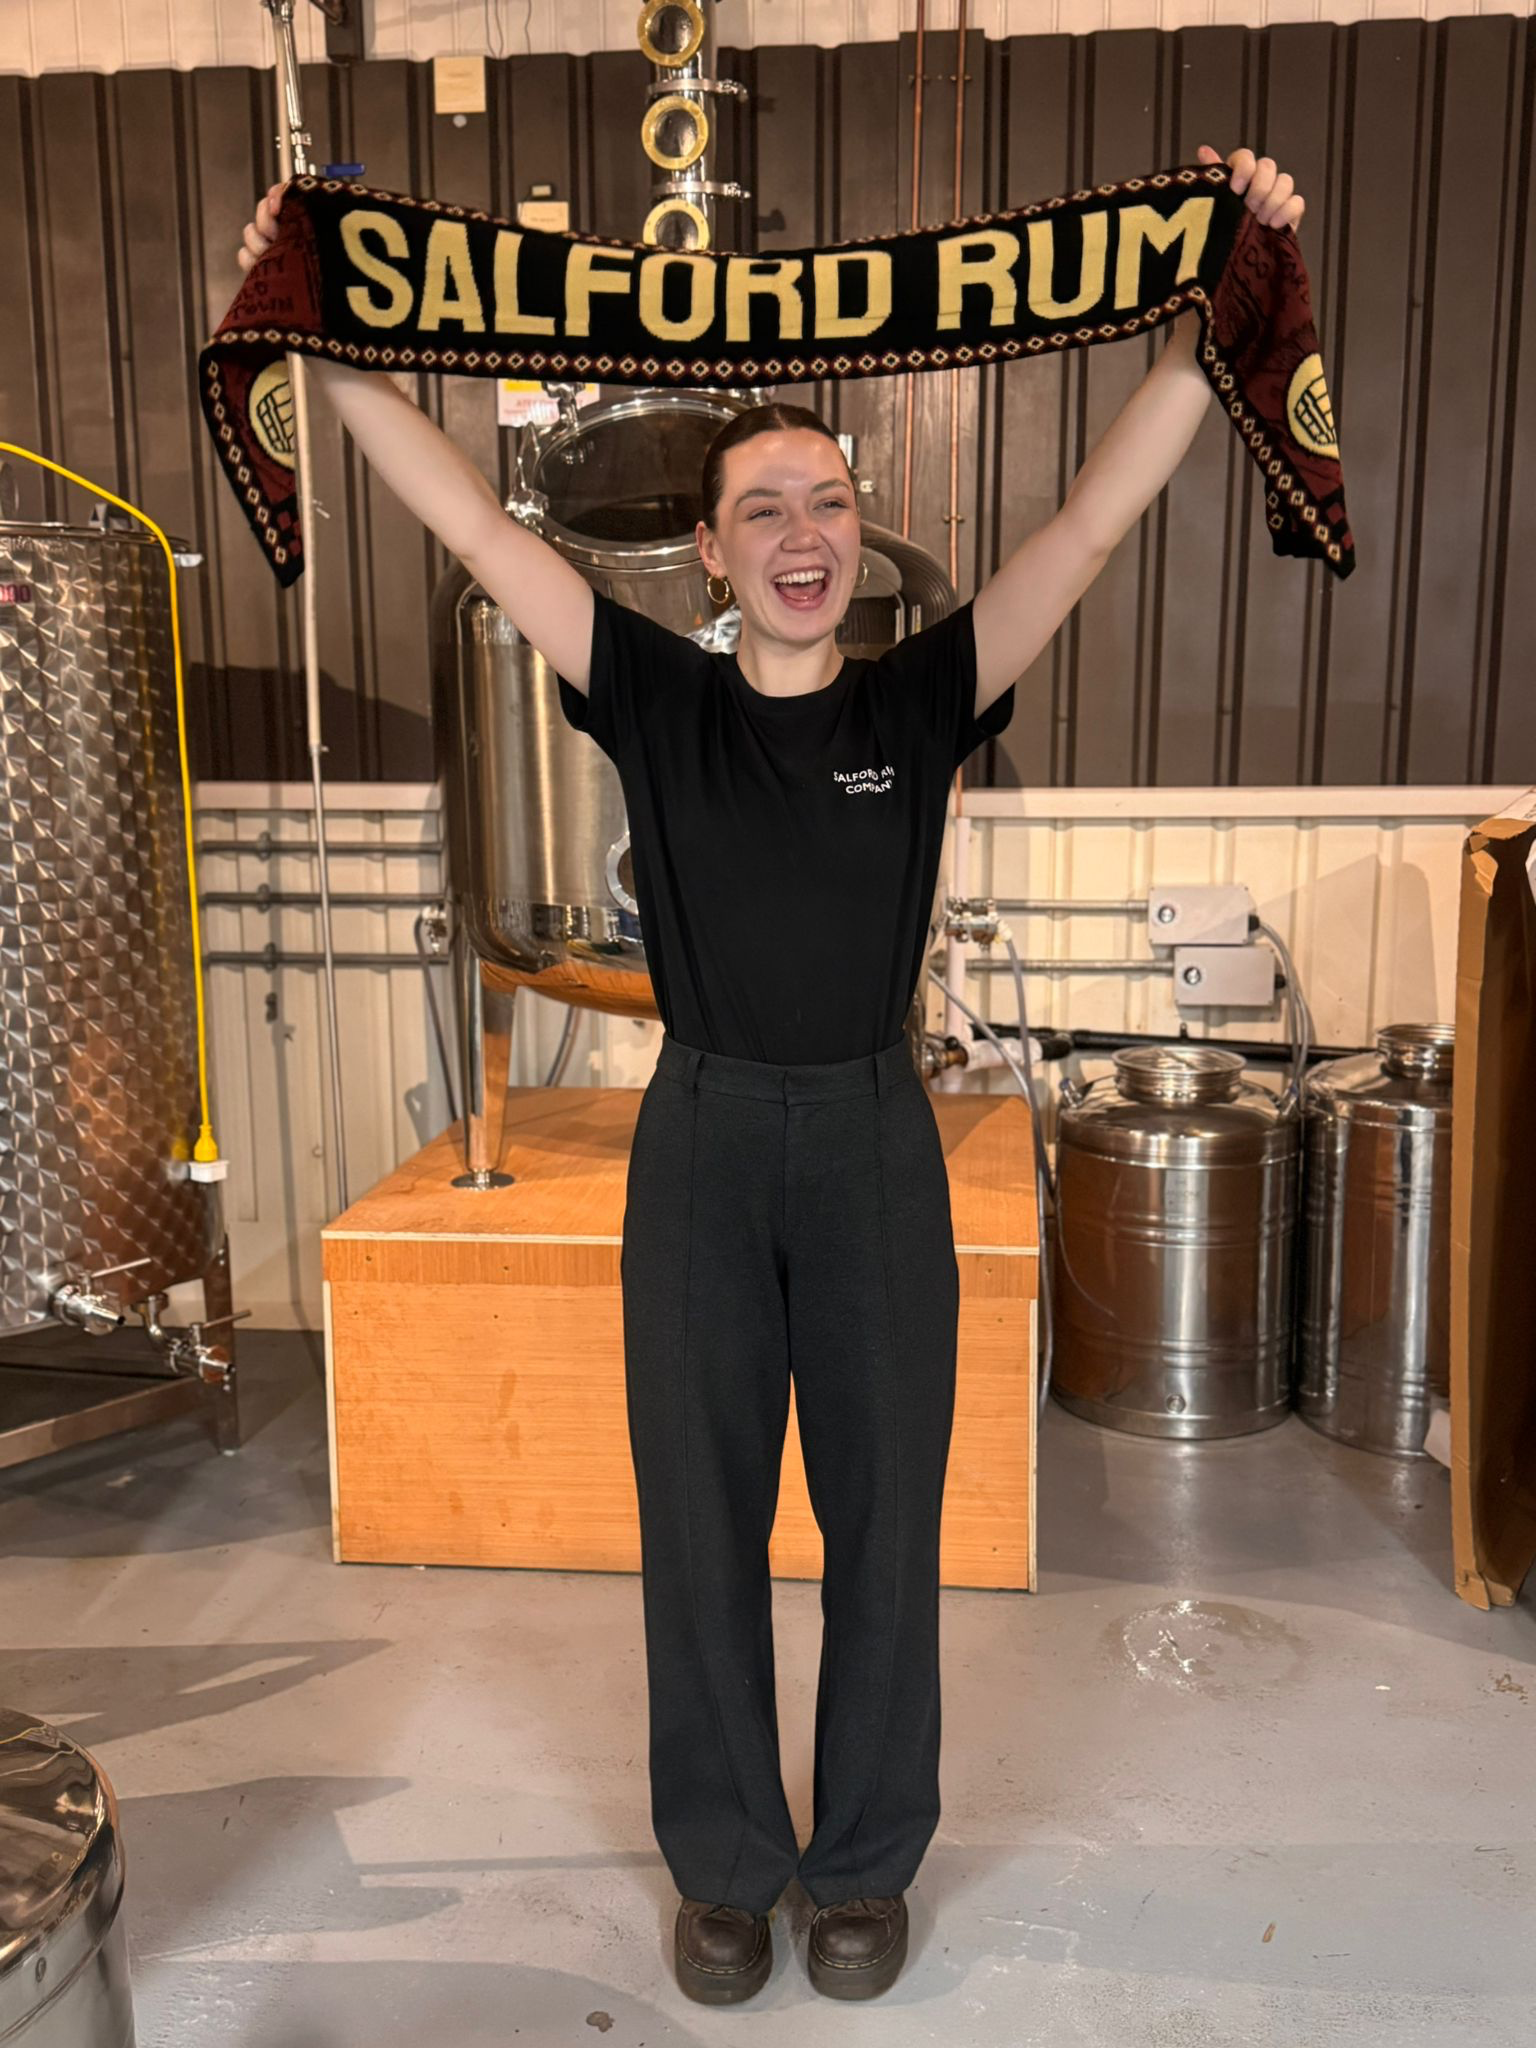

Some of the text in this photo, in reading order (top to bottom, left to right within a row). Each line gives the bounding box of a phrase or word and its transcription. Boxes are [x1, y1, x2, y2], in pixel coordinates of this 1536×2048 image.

[340, 209, 893, 342] SALFORD
[937, 196, 1215, 330] RUM
[833, 768, 879, 783] SALFORD
